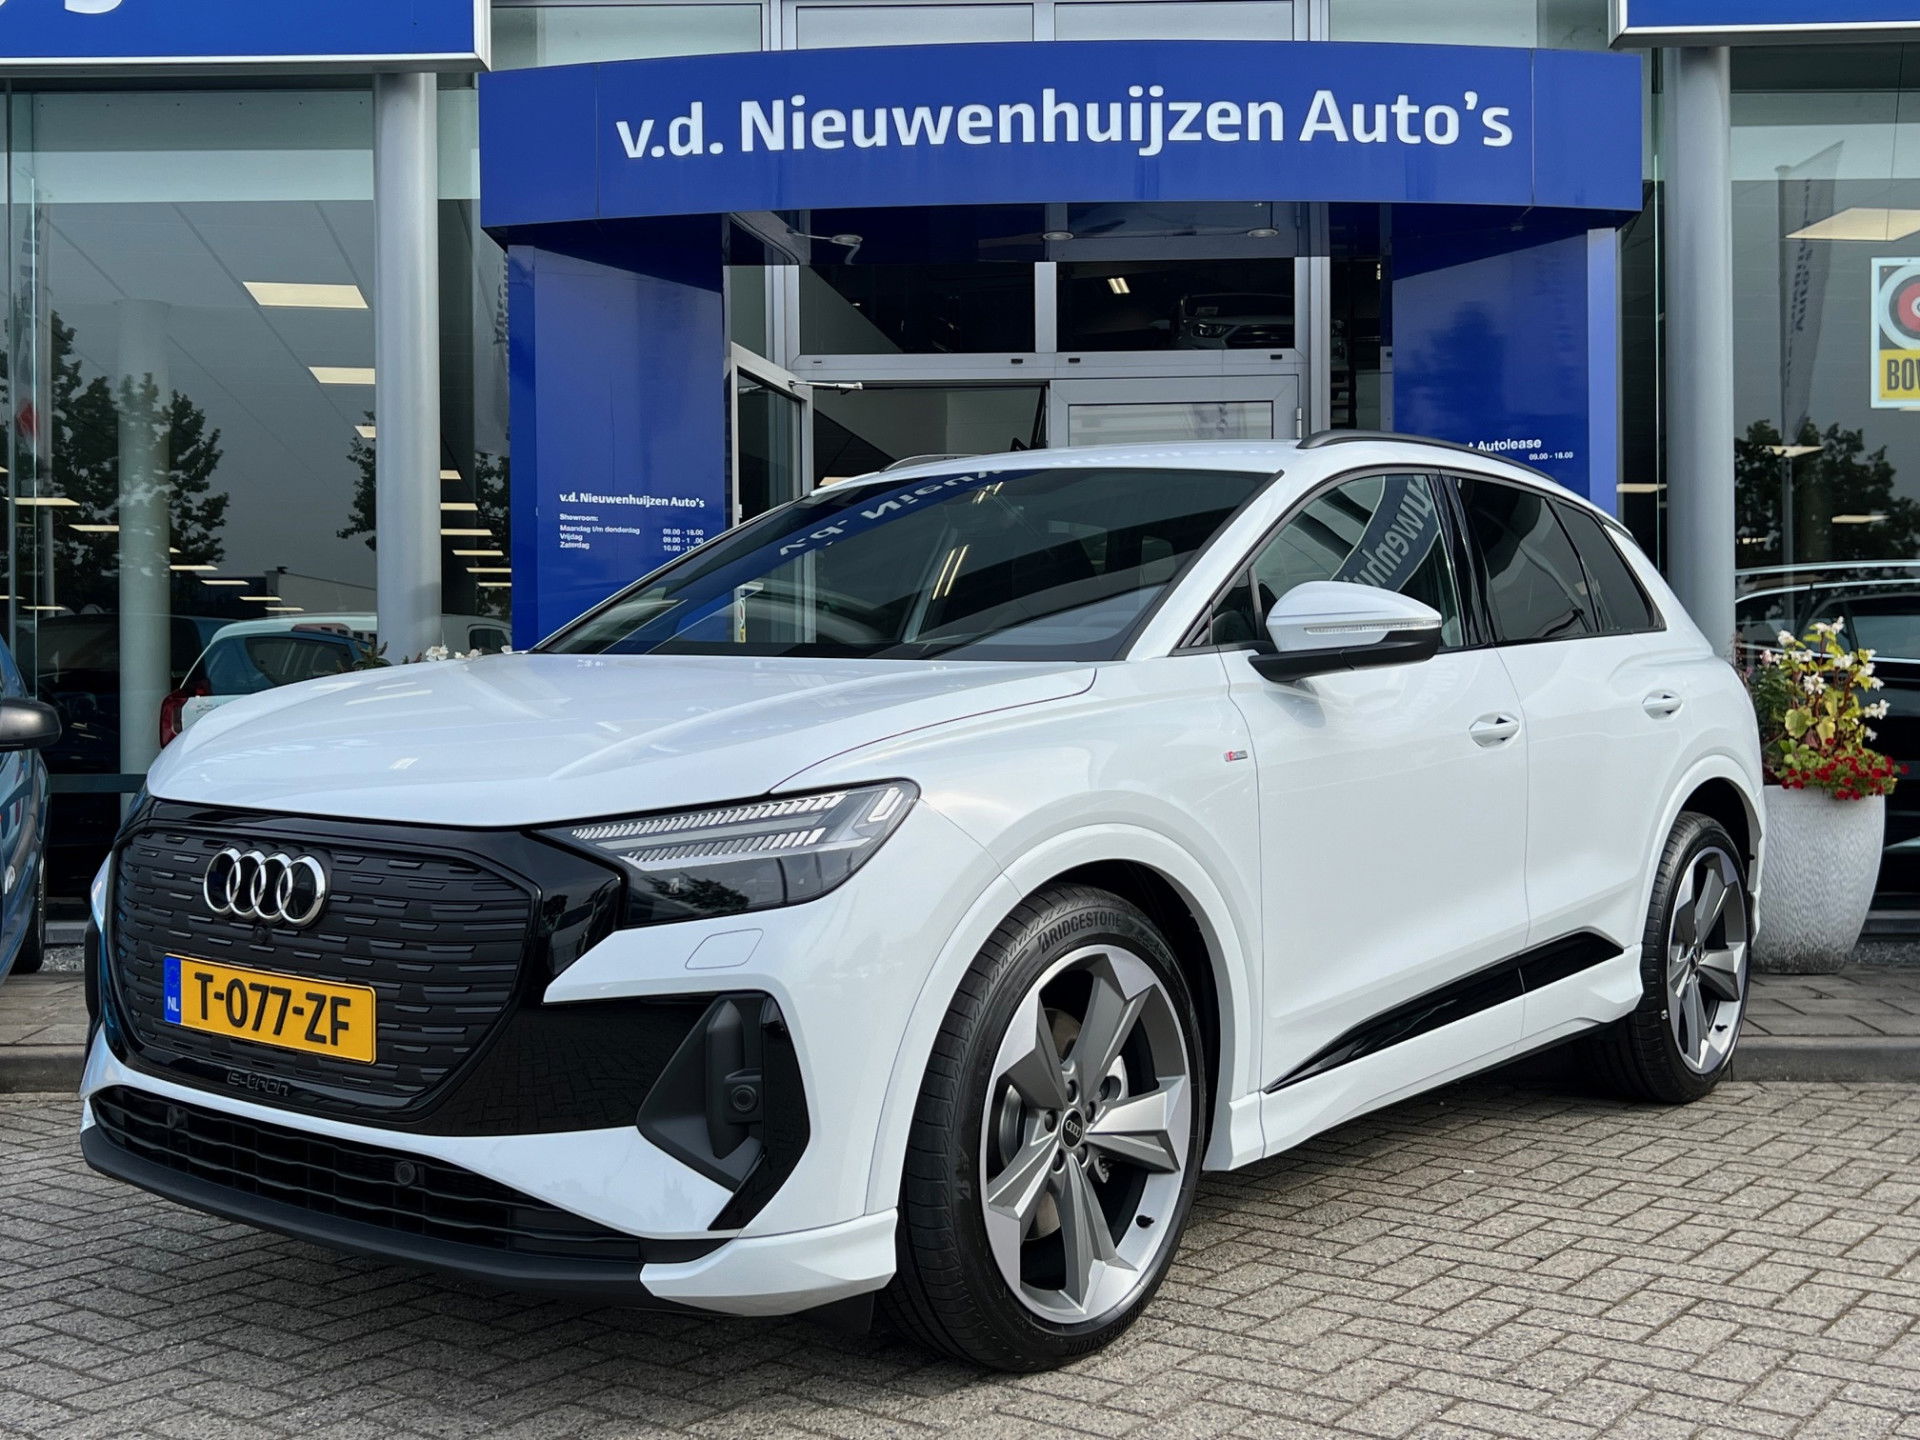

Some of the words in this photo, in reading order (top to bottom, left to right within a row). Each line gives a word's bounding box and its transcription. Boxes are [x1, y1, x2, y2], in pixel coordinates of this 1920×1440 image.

[615, 101, 724, 158] v.d.
[741, 85, 1283, 156] Nieuwenhuijzen
[1299, 89, 1514, 147] Auto's
[1477, 438, 1542, 451] Autolease
[1528, 452, 1548, 461] 09.00
[1554, 451, 1574, 459] 18.00
[559, 492, 579, 503] v.d.
[580, 492, 669, 508] Nieuwenhuijzen
[670, 496, 706, 508] Auto's
[559, 513, 599, 522] Showroom:
[560, 525, 591, 533] Maandag
[604, 526, 640, 535] donderdag
[560, 533, 583, 541] Vrijdag
[560, 541, 590, 550] Zaterdag
[1037, 910, 1121, 954] BRIDGESTONE
[167, 996, 180, 1012] NL
[194, 971, 352, 1047] T-077-ZF
[227, 1070, 289, 1097] e-tron
